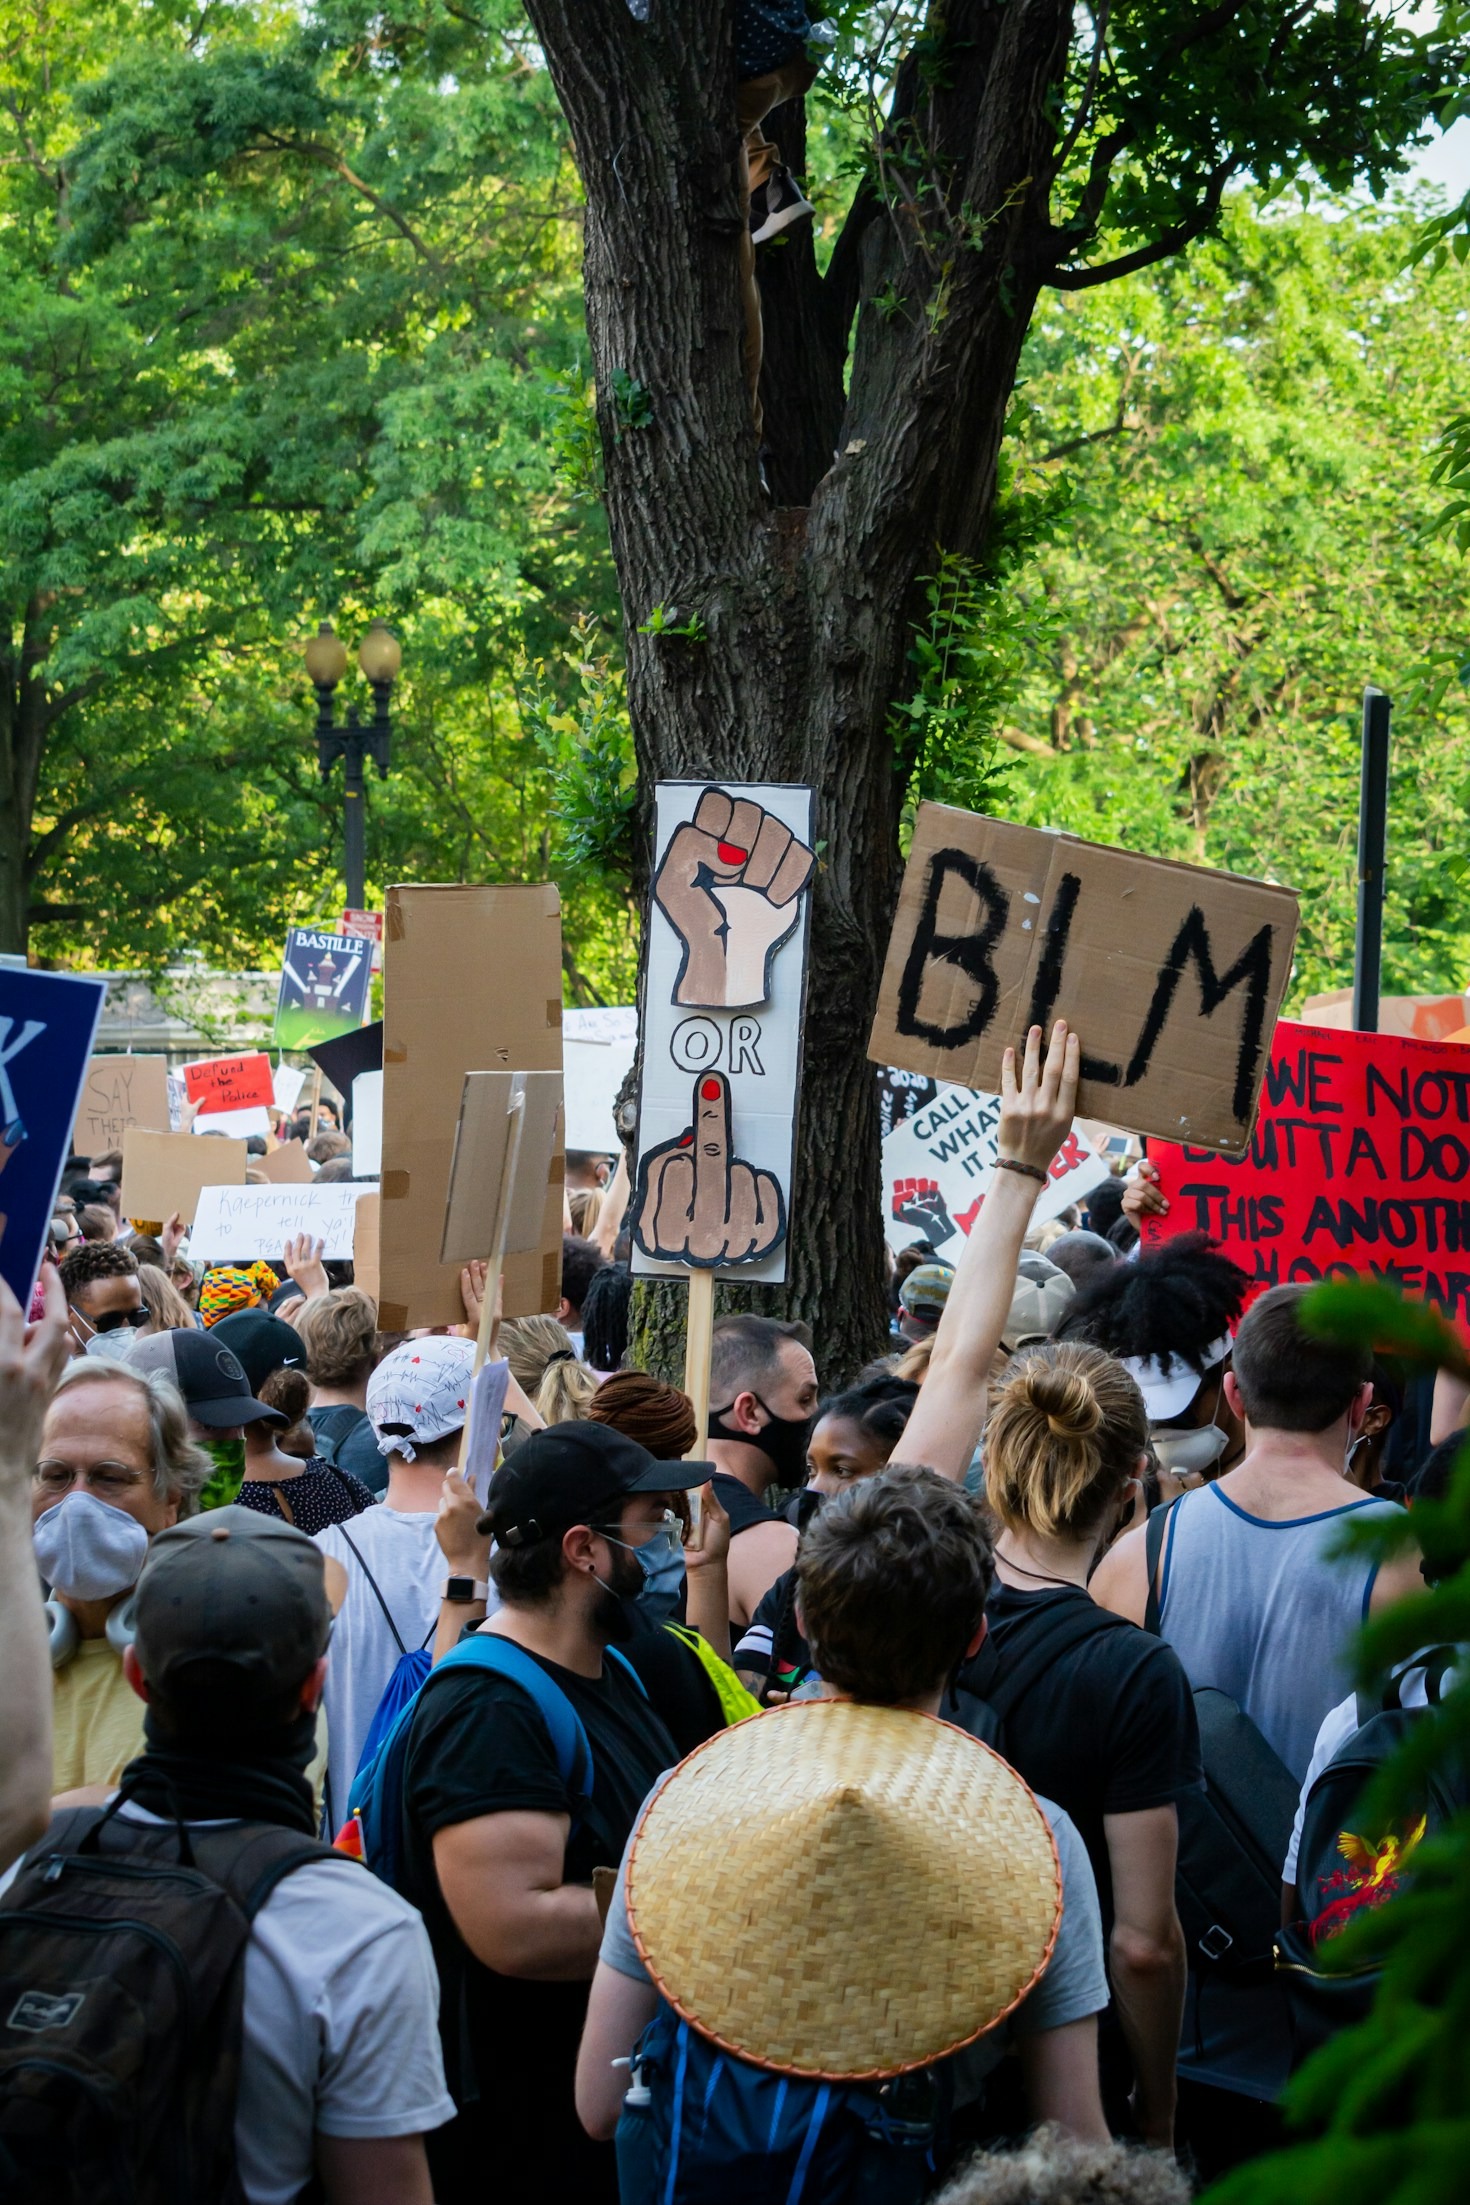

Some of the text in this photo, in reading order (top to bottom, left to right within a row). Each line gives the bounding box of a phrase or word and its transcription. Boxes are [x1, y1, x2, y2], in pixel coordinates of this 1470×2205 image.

[295, 931, 364, 955] BASTILLE
[897, 848, 1273, 1124] BLM
[669, 1015, 766, 1076] OR
[190, 1062, 244, 1080] Defund
[211, 1078, 233, 1087] the
[887, 1066, 929, 1091] 2020
[1264, 1048, 1470, 1122] WE NOT
[87, 1069, 133, 1114] SAY
[222, 1091, 259, 1102] Police
[881, 1090, 893, 1137] olice
[913, 1094, 970, 1140] CALL
[961, 1151, 984, 1178] IT
[1401, 1126, 1470, 1183] DO
[220, 1190, 320, 1218] Kaepernick
[1180, 1184, 1285, 1243] THIS
[216, 1221, 232, 1236] to
[278, 1215, 304, 1228] tell
